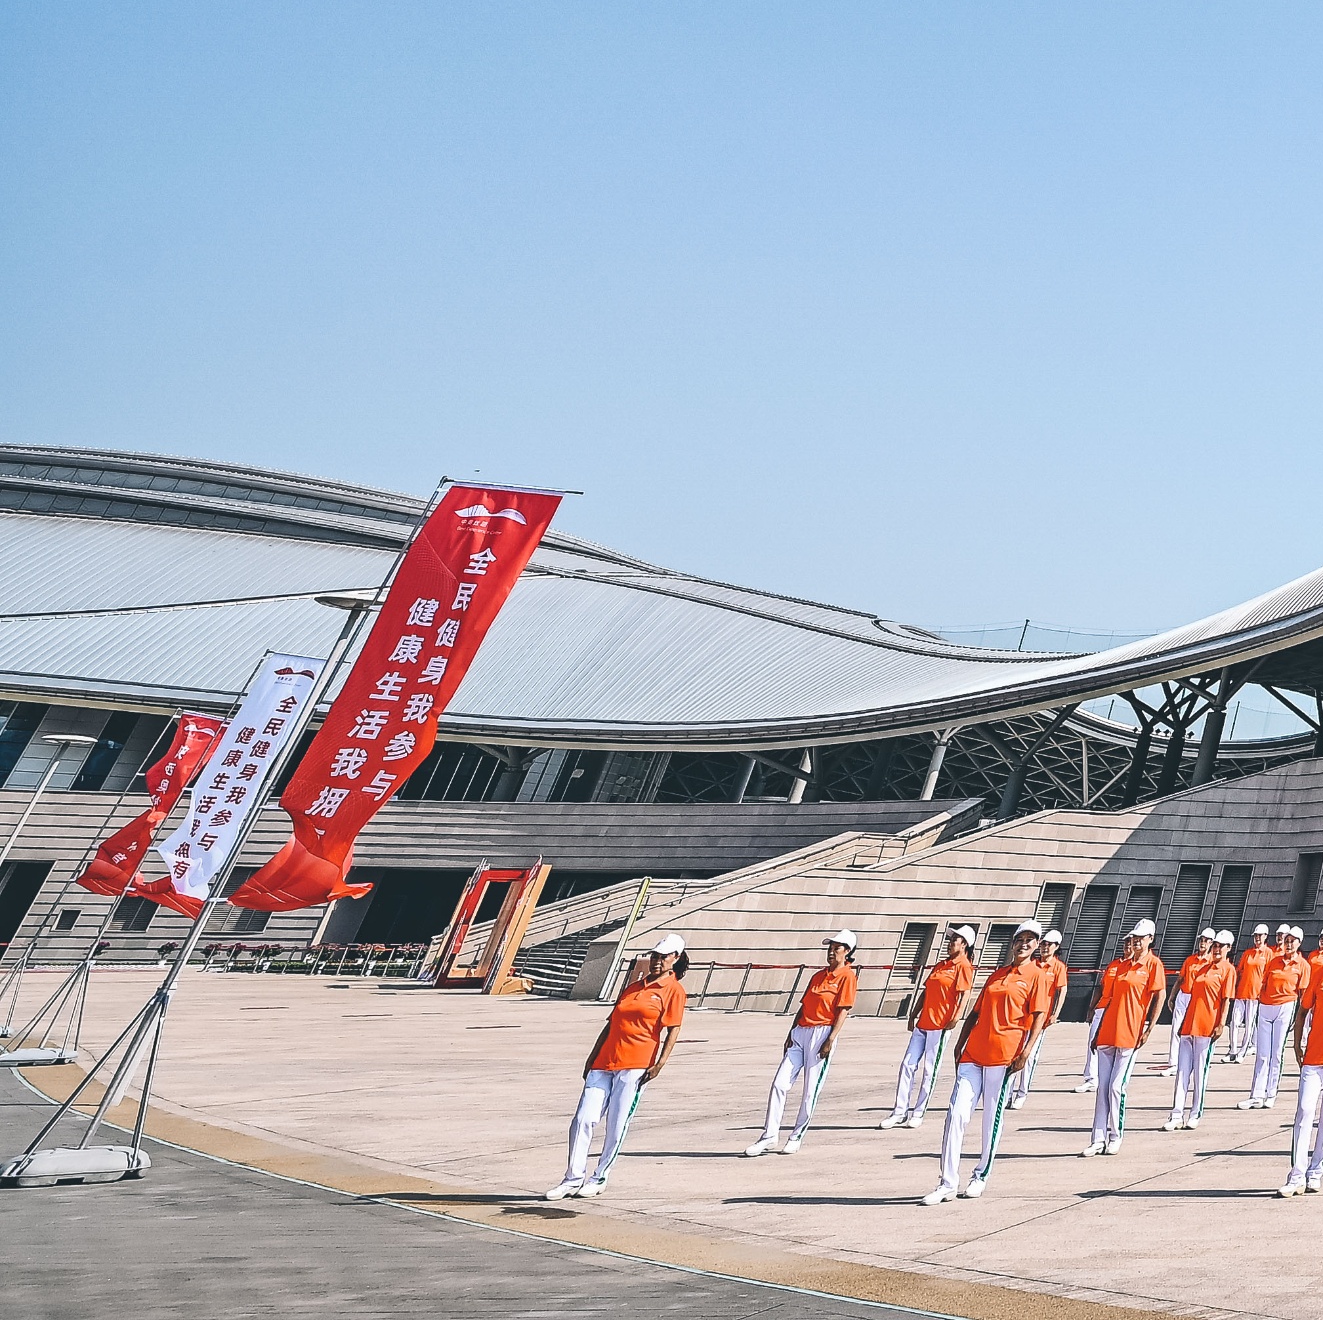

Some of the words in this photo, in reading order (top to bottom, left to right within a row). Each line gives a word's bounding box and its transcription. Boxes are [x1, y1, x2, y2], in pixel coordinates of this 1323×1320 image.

[197, 695, 298, 851] 全民健身我参与
[305, 597, 439, 840] 健康生活我拥
[362, 547, 497, 801] 全民健身我参与
